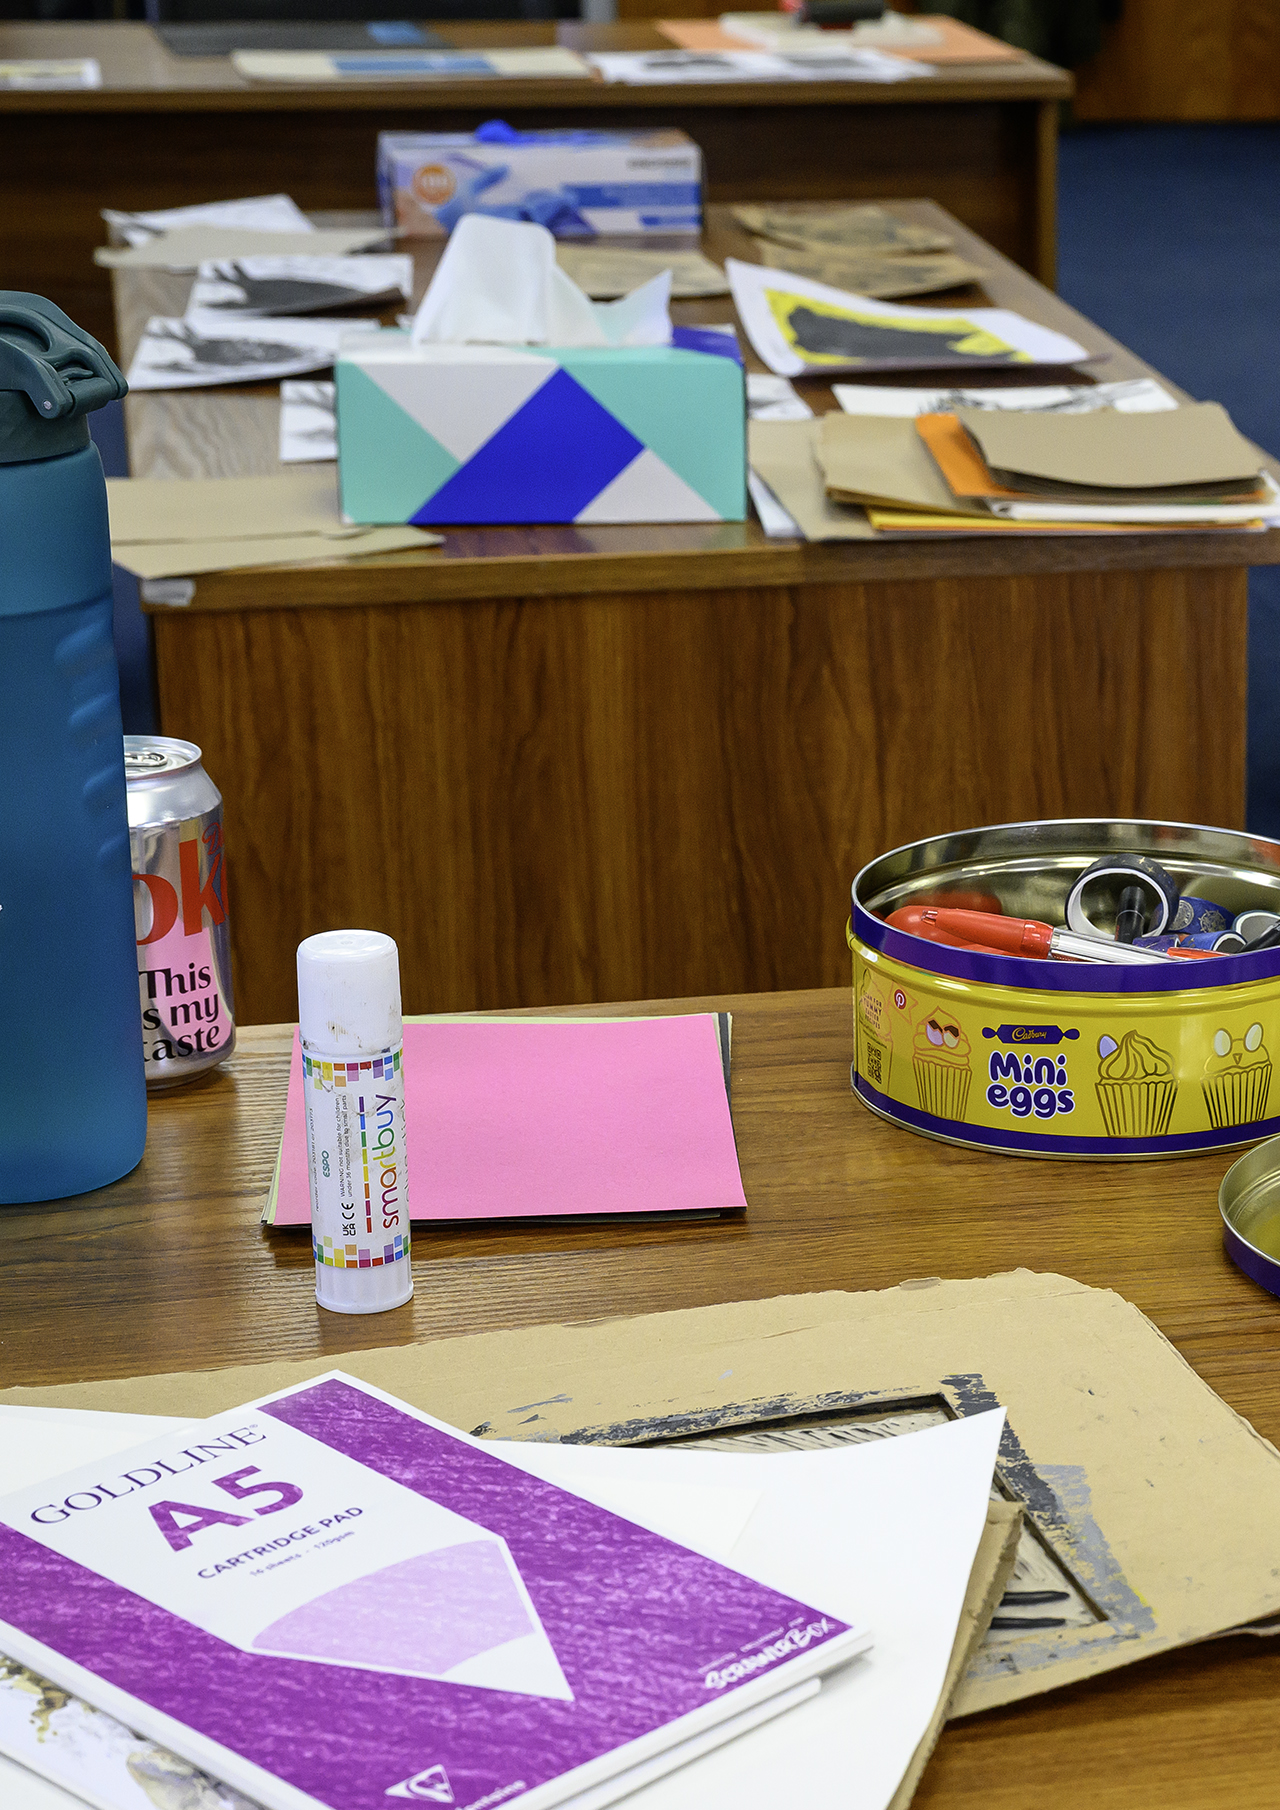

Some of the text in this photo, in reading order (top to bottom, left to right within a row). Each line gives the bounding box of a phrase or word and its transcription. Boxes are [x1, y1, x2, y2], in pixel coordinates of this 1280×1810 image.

[138, 962, 211, 1000] This
[142, 994, 220, 1030] s my
[1012, 1027, 1047, 1041] Cadbury
[989, 1050, 1068, 1086] Mini
[986, 1084, 1075, 1119] eggs
[322, 1150, 330, 1178] ESPO
[372, 1094, 399, 1229] smartbuy
[30, 1427, 267, 1524] GOLDLINE
[148, 1465, 304, 1552] A5
[197, 1506, 364, 1579] CARTRIDGE PAD
[266, 1551, 302, 1571] sheets
[313, 1530, 355, 1550] 120gsm
